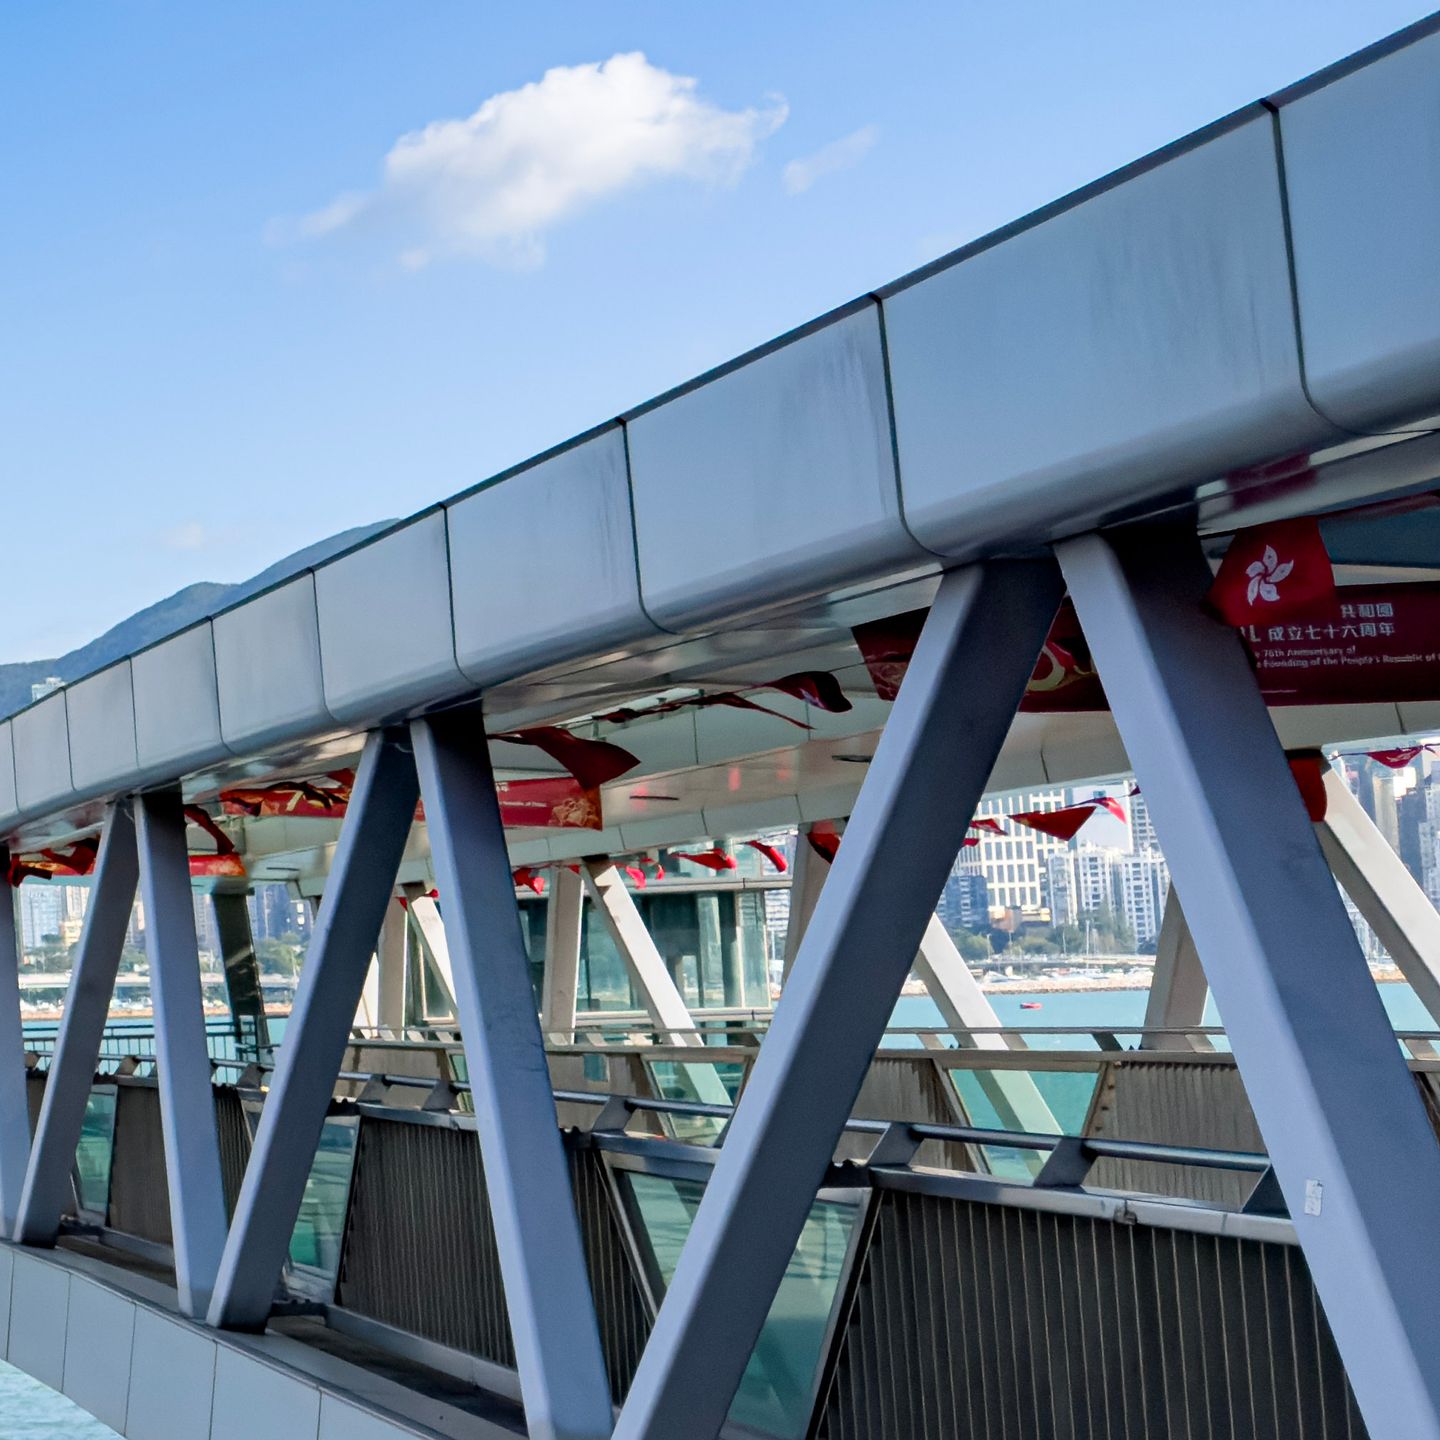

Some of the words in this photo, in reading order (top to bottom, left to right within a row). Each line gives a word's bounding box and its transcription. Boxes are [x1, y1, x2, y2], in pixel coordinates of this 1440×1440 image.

[1268, 623, 1394, 641] 成立七十六周年
